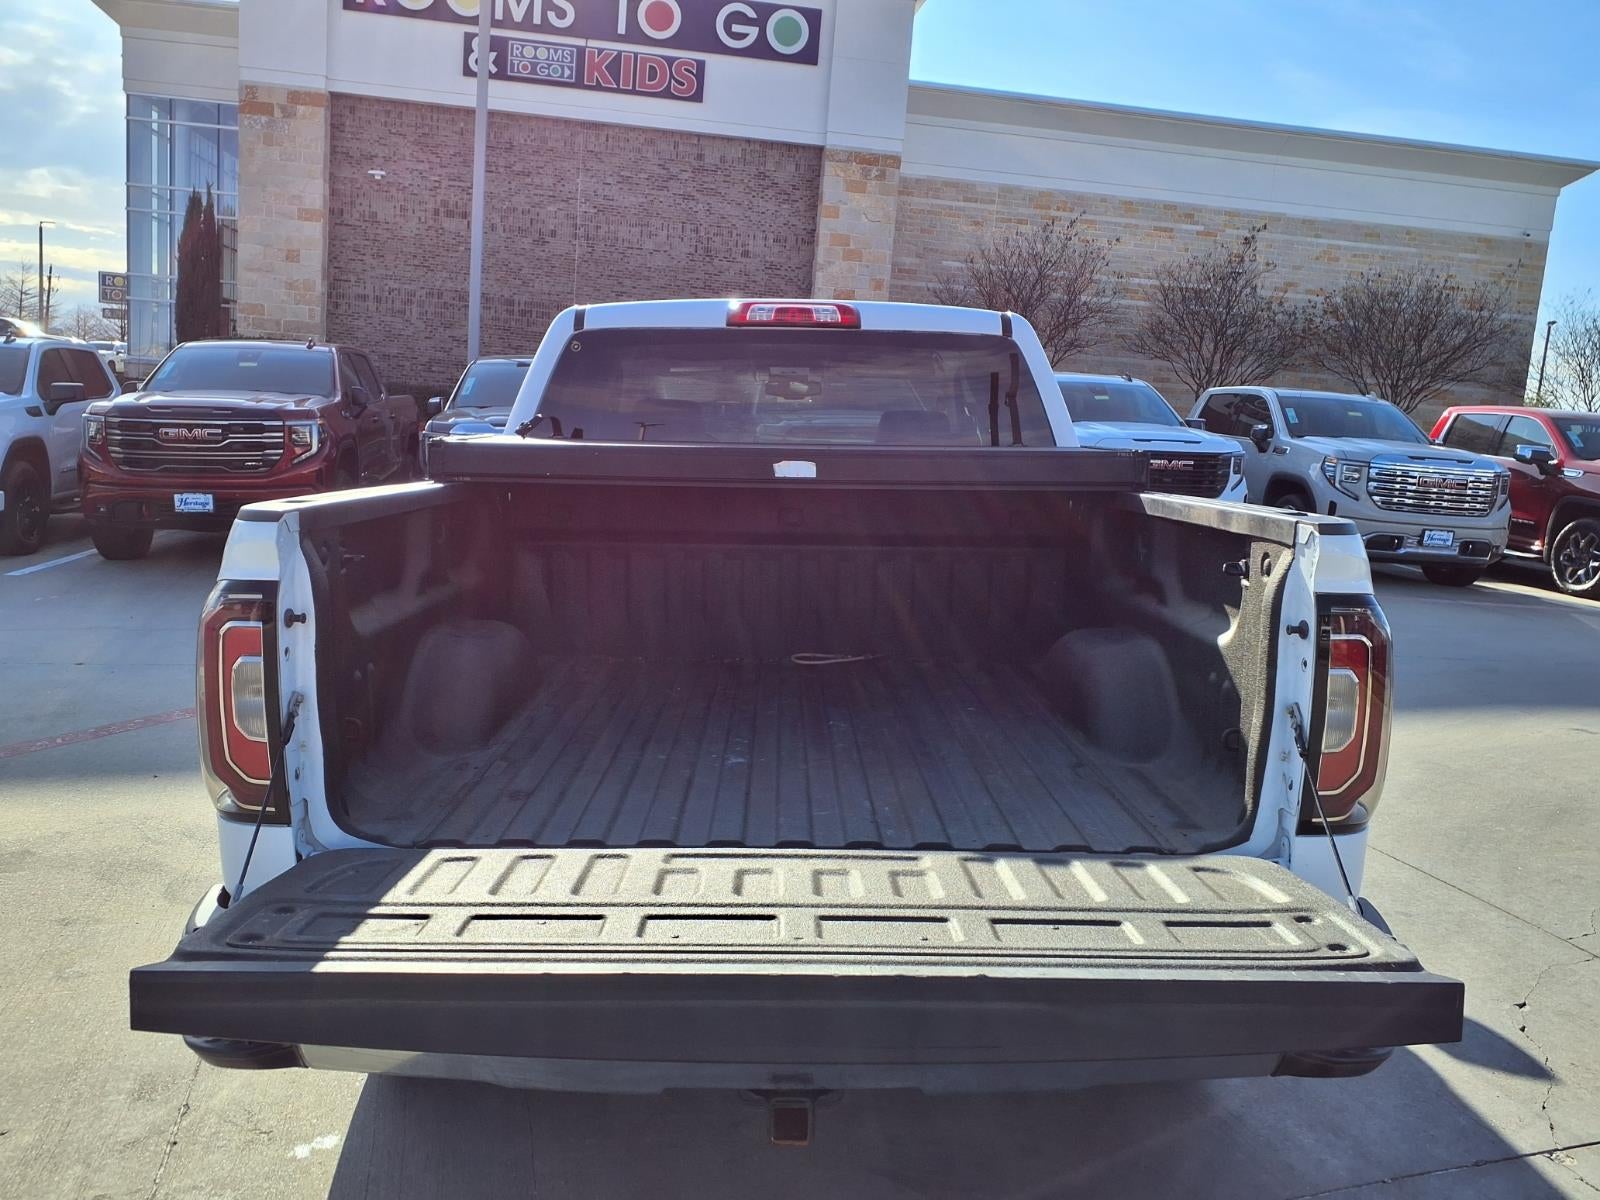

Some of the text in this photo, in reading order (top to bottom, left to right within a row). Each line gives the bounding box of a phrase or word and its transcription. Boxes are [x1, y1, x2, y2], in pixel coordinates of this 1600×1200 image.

[715, 2, 810, 55] GO
[513, 44, 571, 62] ROOMS
[513, 60, 562, 77] TO GO
[584, 48, 698, 97] KIDS
[159, 428, 222, 440] GMC
[1420, 477, 1467, 489] GMC
[176, 496, 210, 508] Heritage
